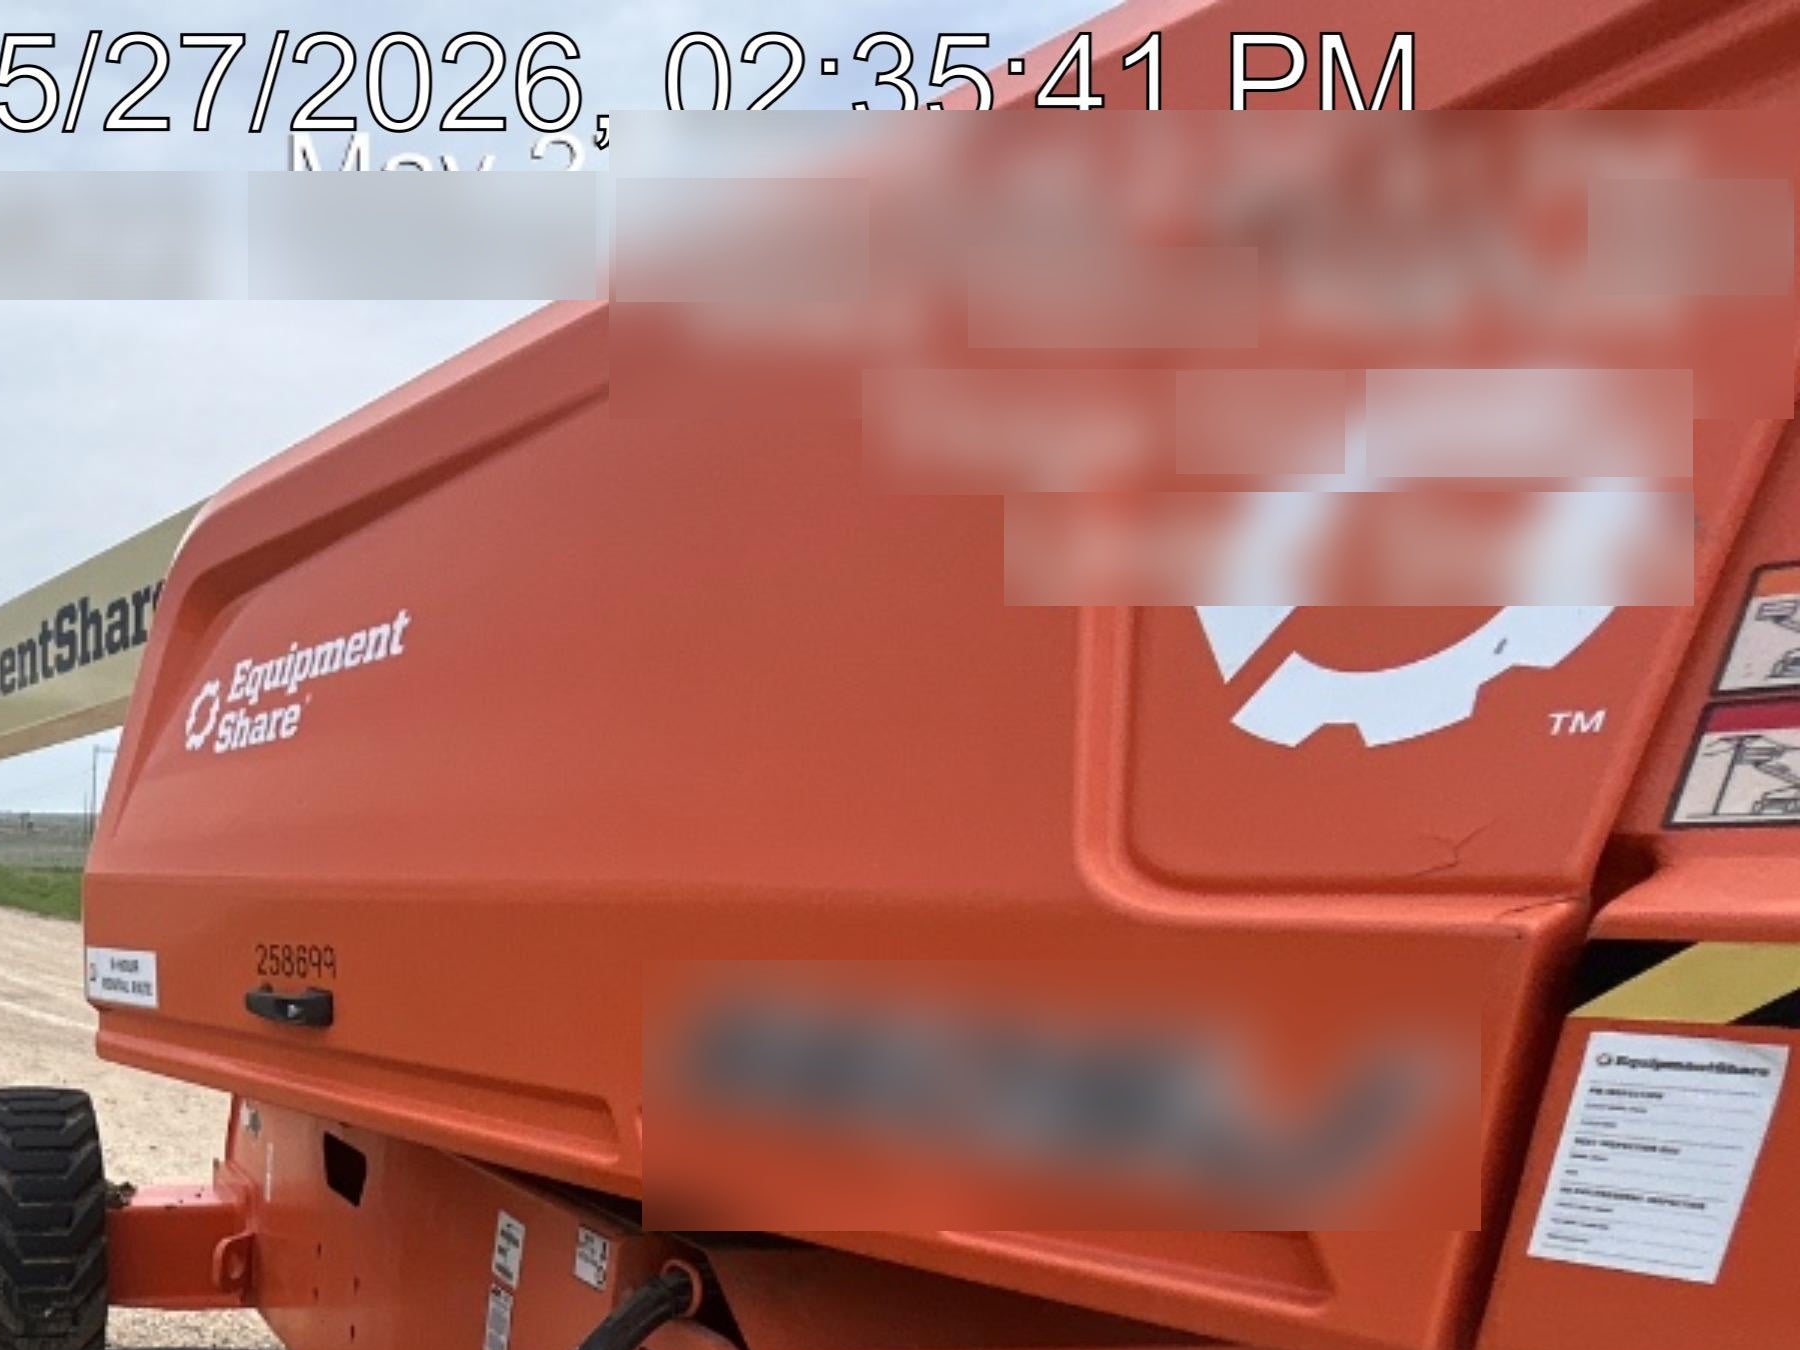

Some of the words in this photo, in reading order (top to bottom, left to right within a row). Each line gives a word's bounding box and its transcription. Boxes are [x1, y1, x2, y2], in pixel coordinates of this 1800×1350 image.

[227, 608, 411, 706] Equipment
[214, 702, 301, 754] Share
[1548, 710, 1606, 735] TM
[255, 943, 337, 980] 258699
